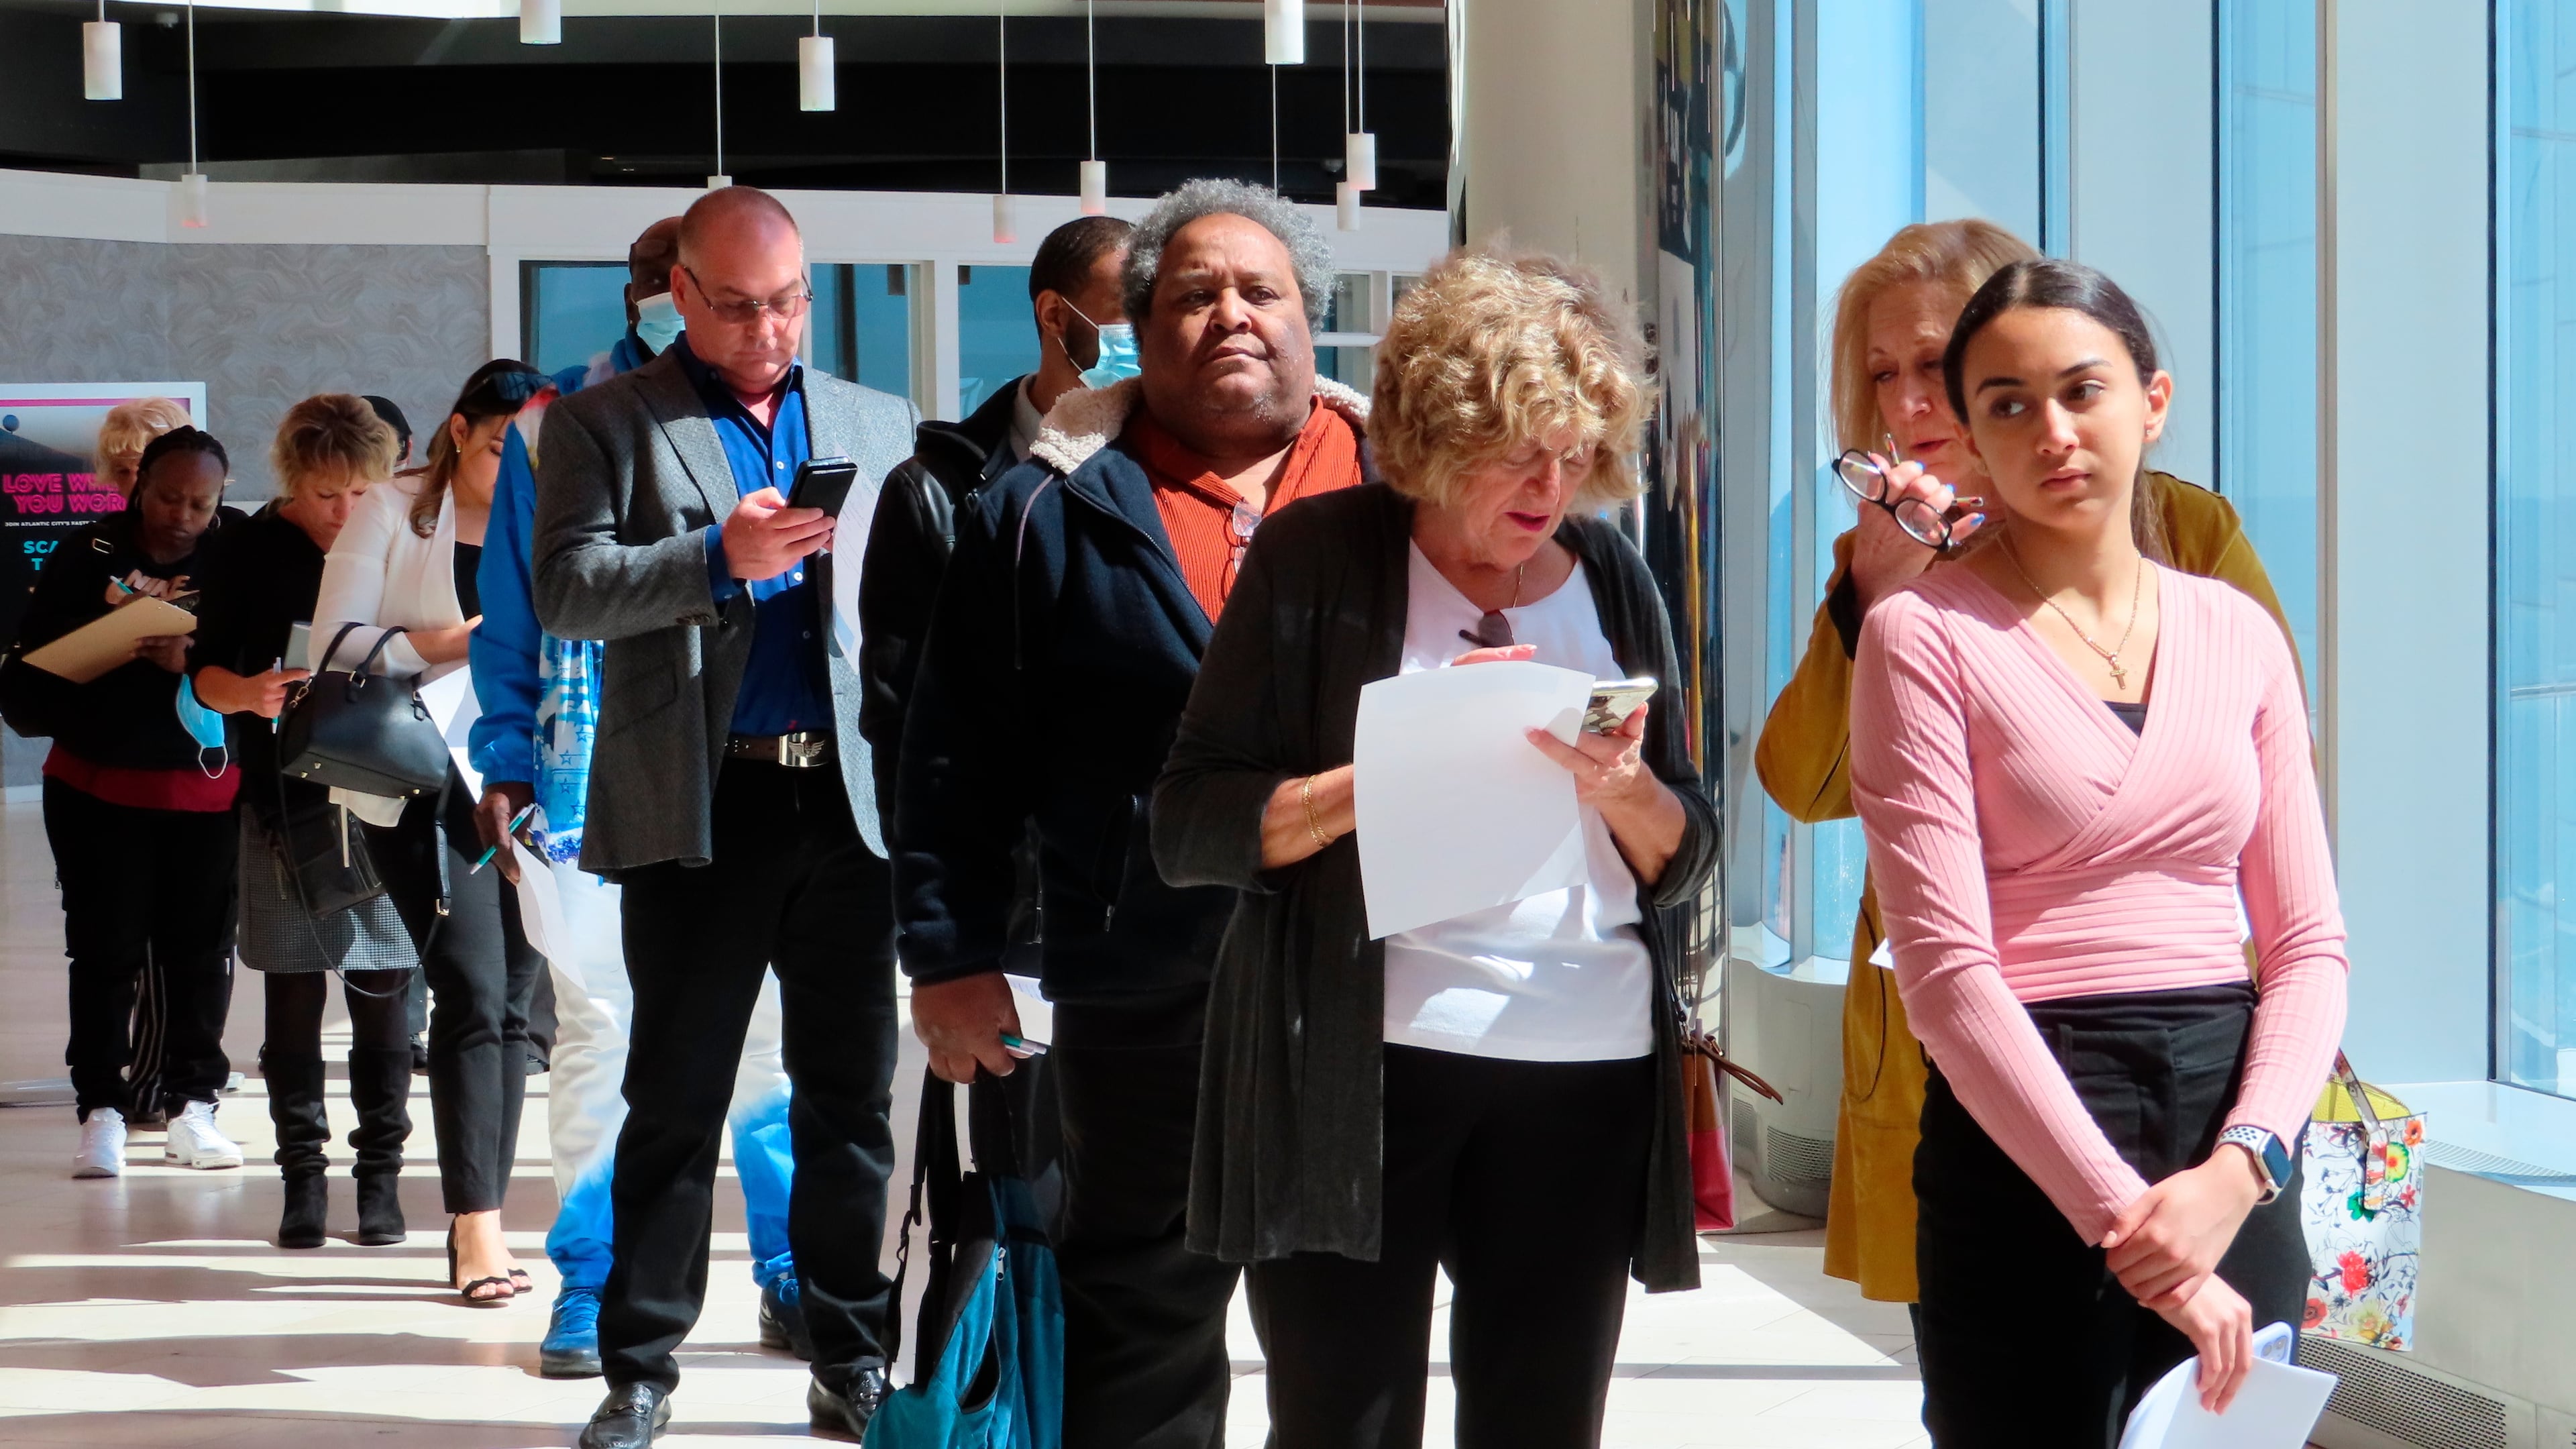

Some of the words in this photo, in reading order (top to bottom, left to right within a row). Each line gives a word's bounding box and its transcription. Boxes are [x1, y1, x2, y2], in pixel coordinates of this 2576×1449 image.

[3, 473, 63, 493] LOVE
[13, 494, 64, 513] YOU
[68, 493, 127, 513] WOR
